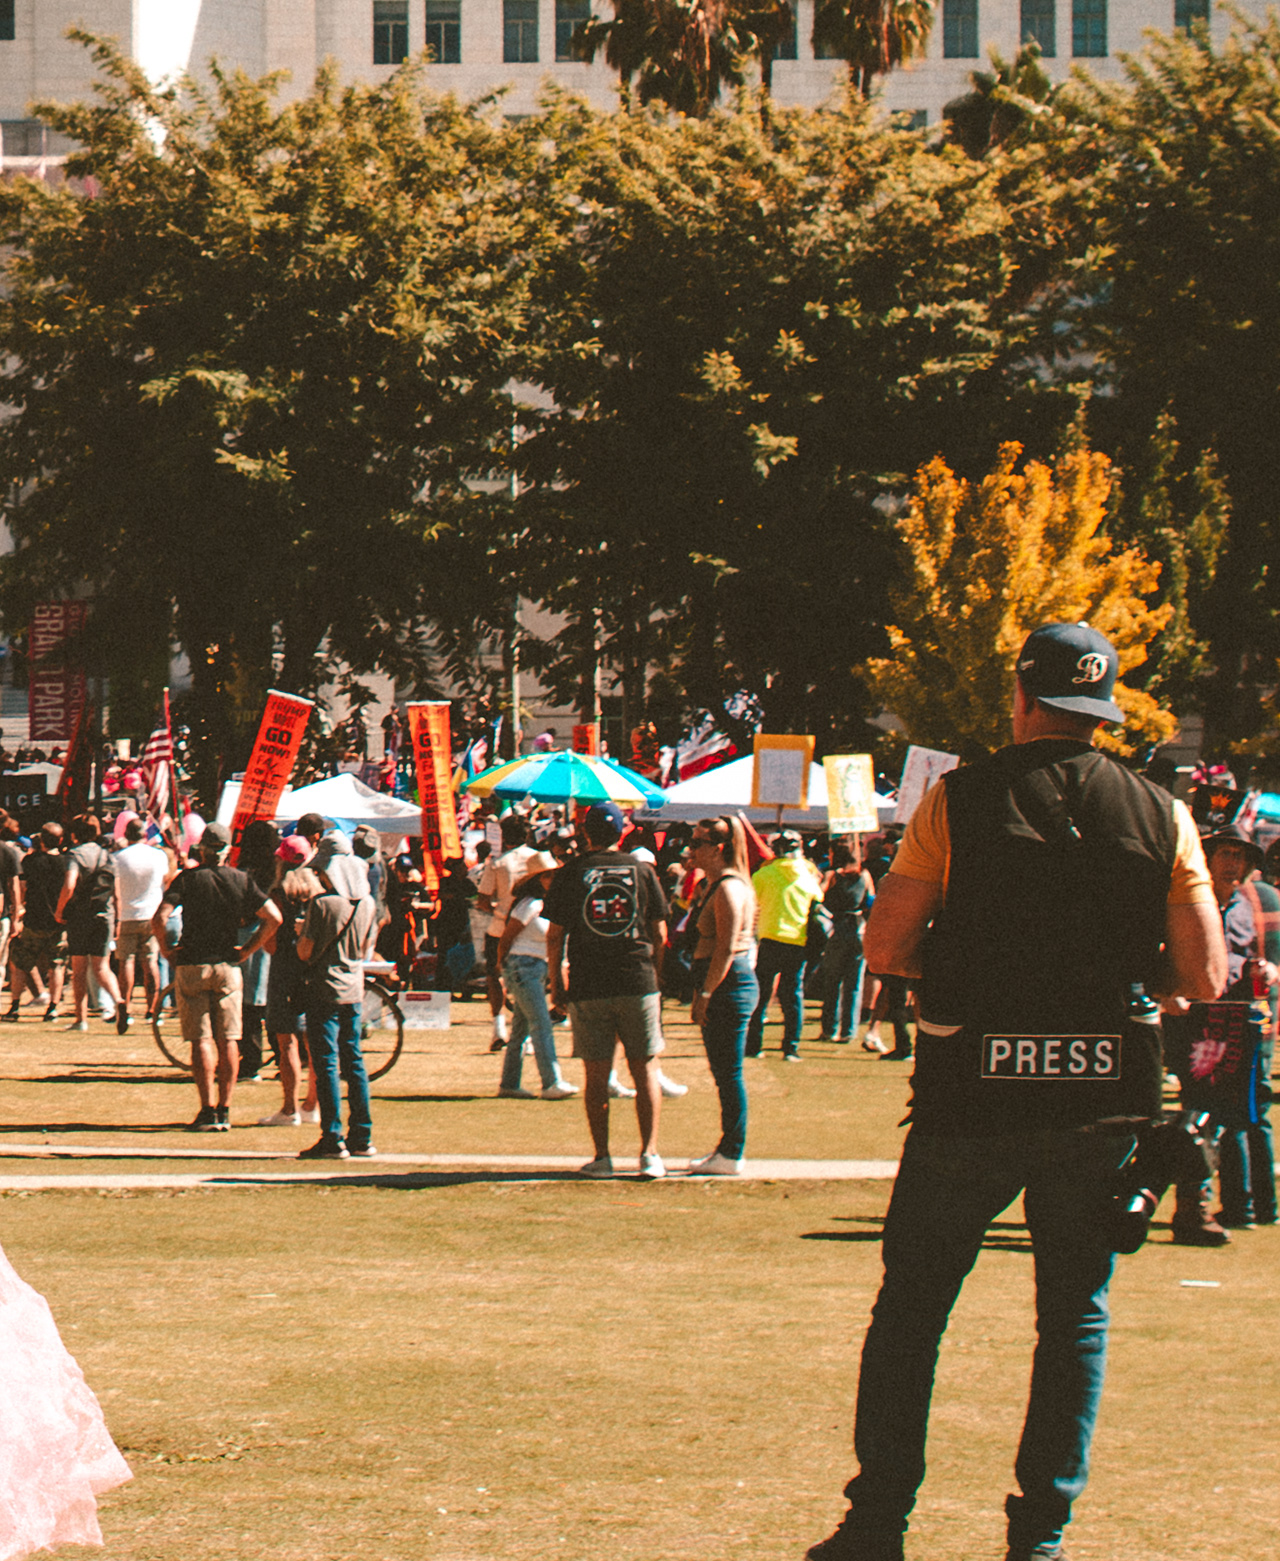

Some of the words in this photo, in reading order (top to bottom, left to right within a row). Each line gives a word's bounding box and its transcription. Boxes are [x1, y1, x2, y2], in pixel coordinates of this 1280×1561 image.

[34, 682, 65, 736] PARK
[265, 727, 292, 746] GO
[5, 794, 41, 808] ICE
[990, 1039, 1113, 1074] PRESS
